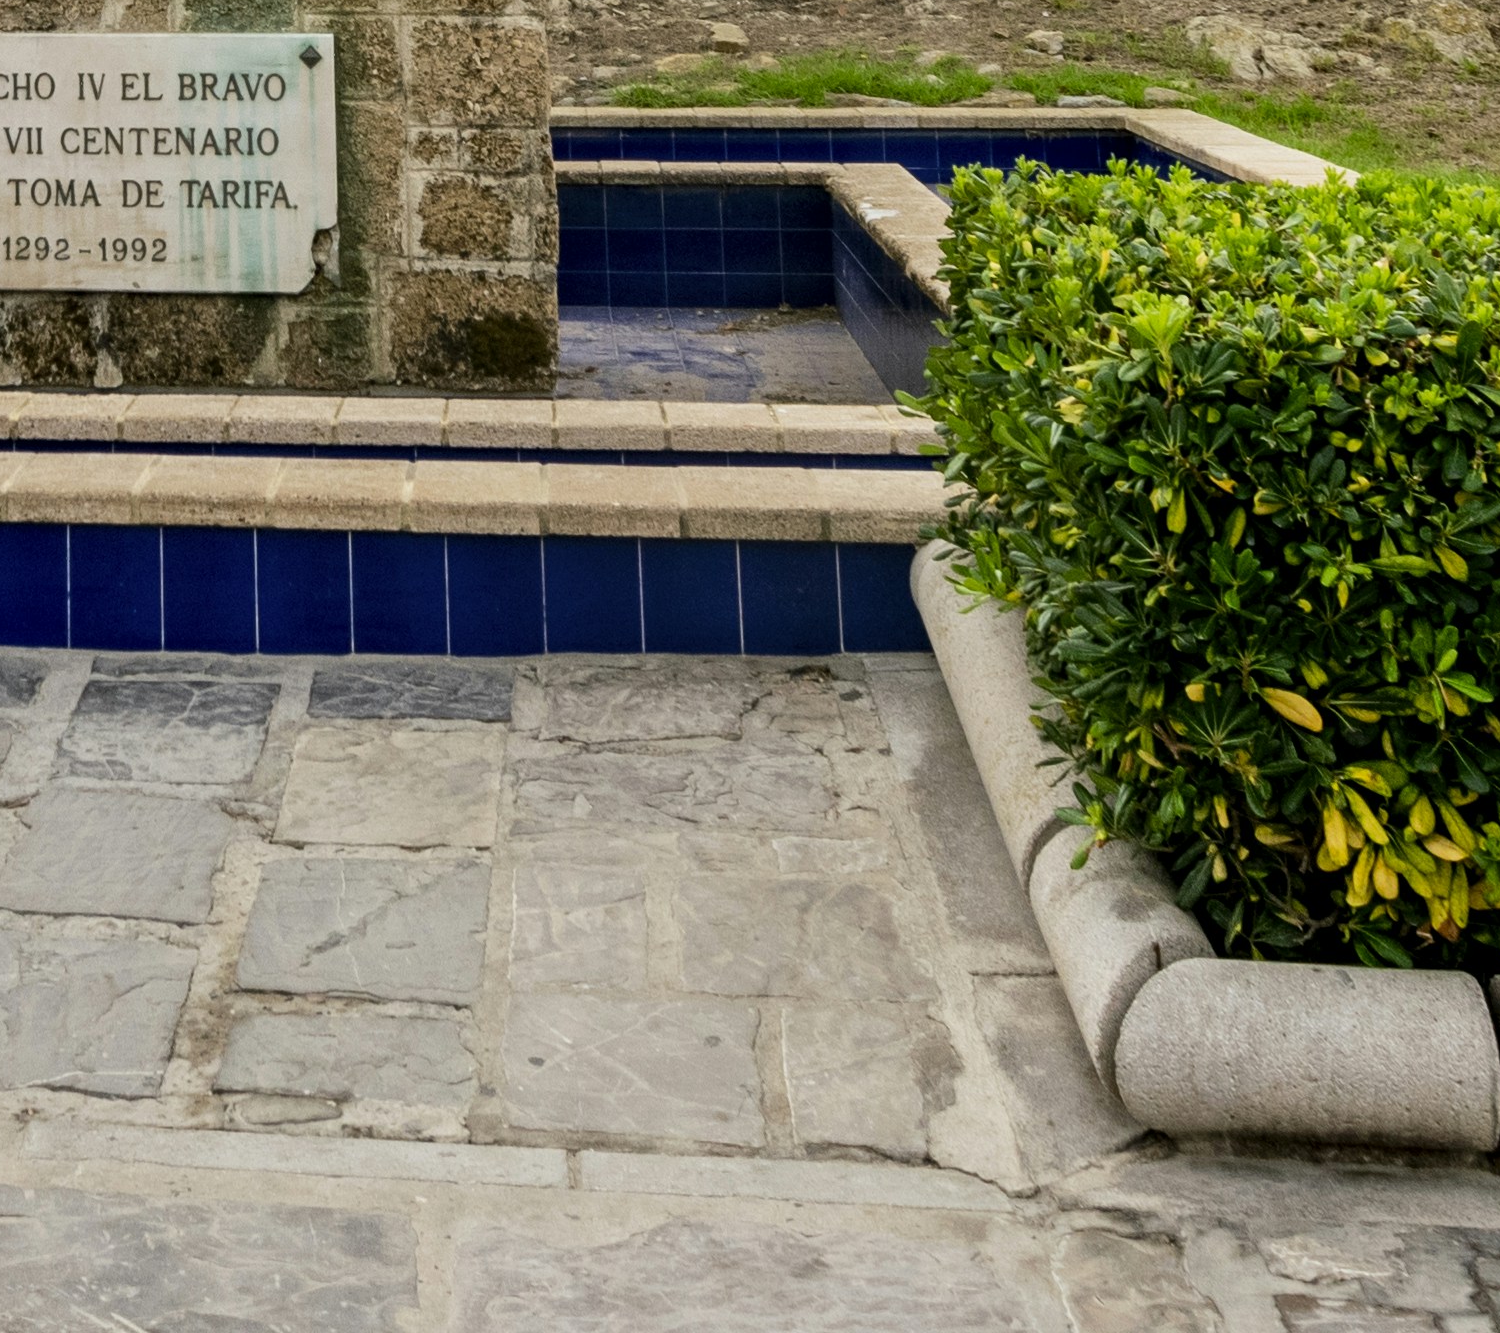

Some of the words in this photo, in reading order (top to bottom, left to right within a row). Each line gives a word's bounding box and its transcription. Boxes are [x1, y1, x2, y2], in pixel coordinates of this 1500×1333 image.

[76, 71, 106, 103] IV
[119, 71, 164, 103] EL
[176, 71, 288, 103] BRAVO
[2, 126, 44, 157] VII
[59, 125, 281, 158] CENTENARIO
[6, 177, 102, 209] TOMA
[120, 178, 166, 210] DE
[180, 177, 299, 212] TARIFA.
